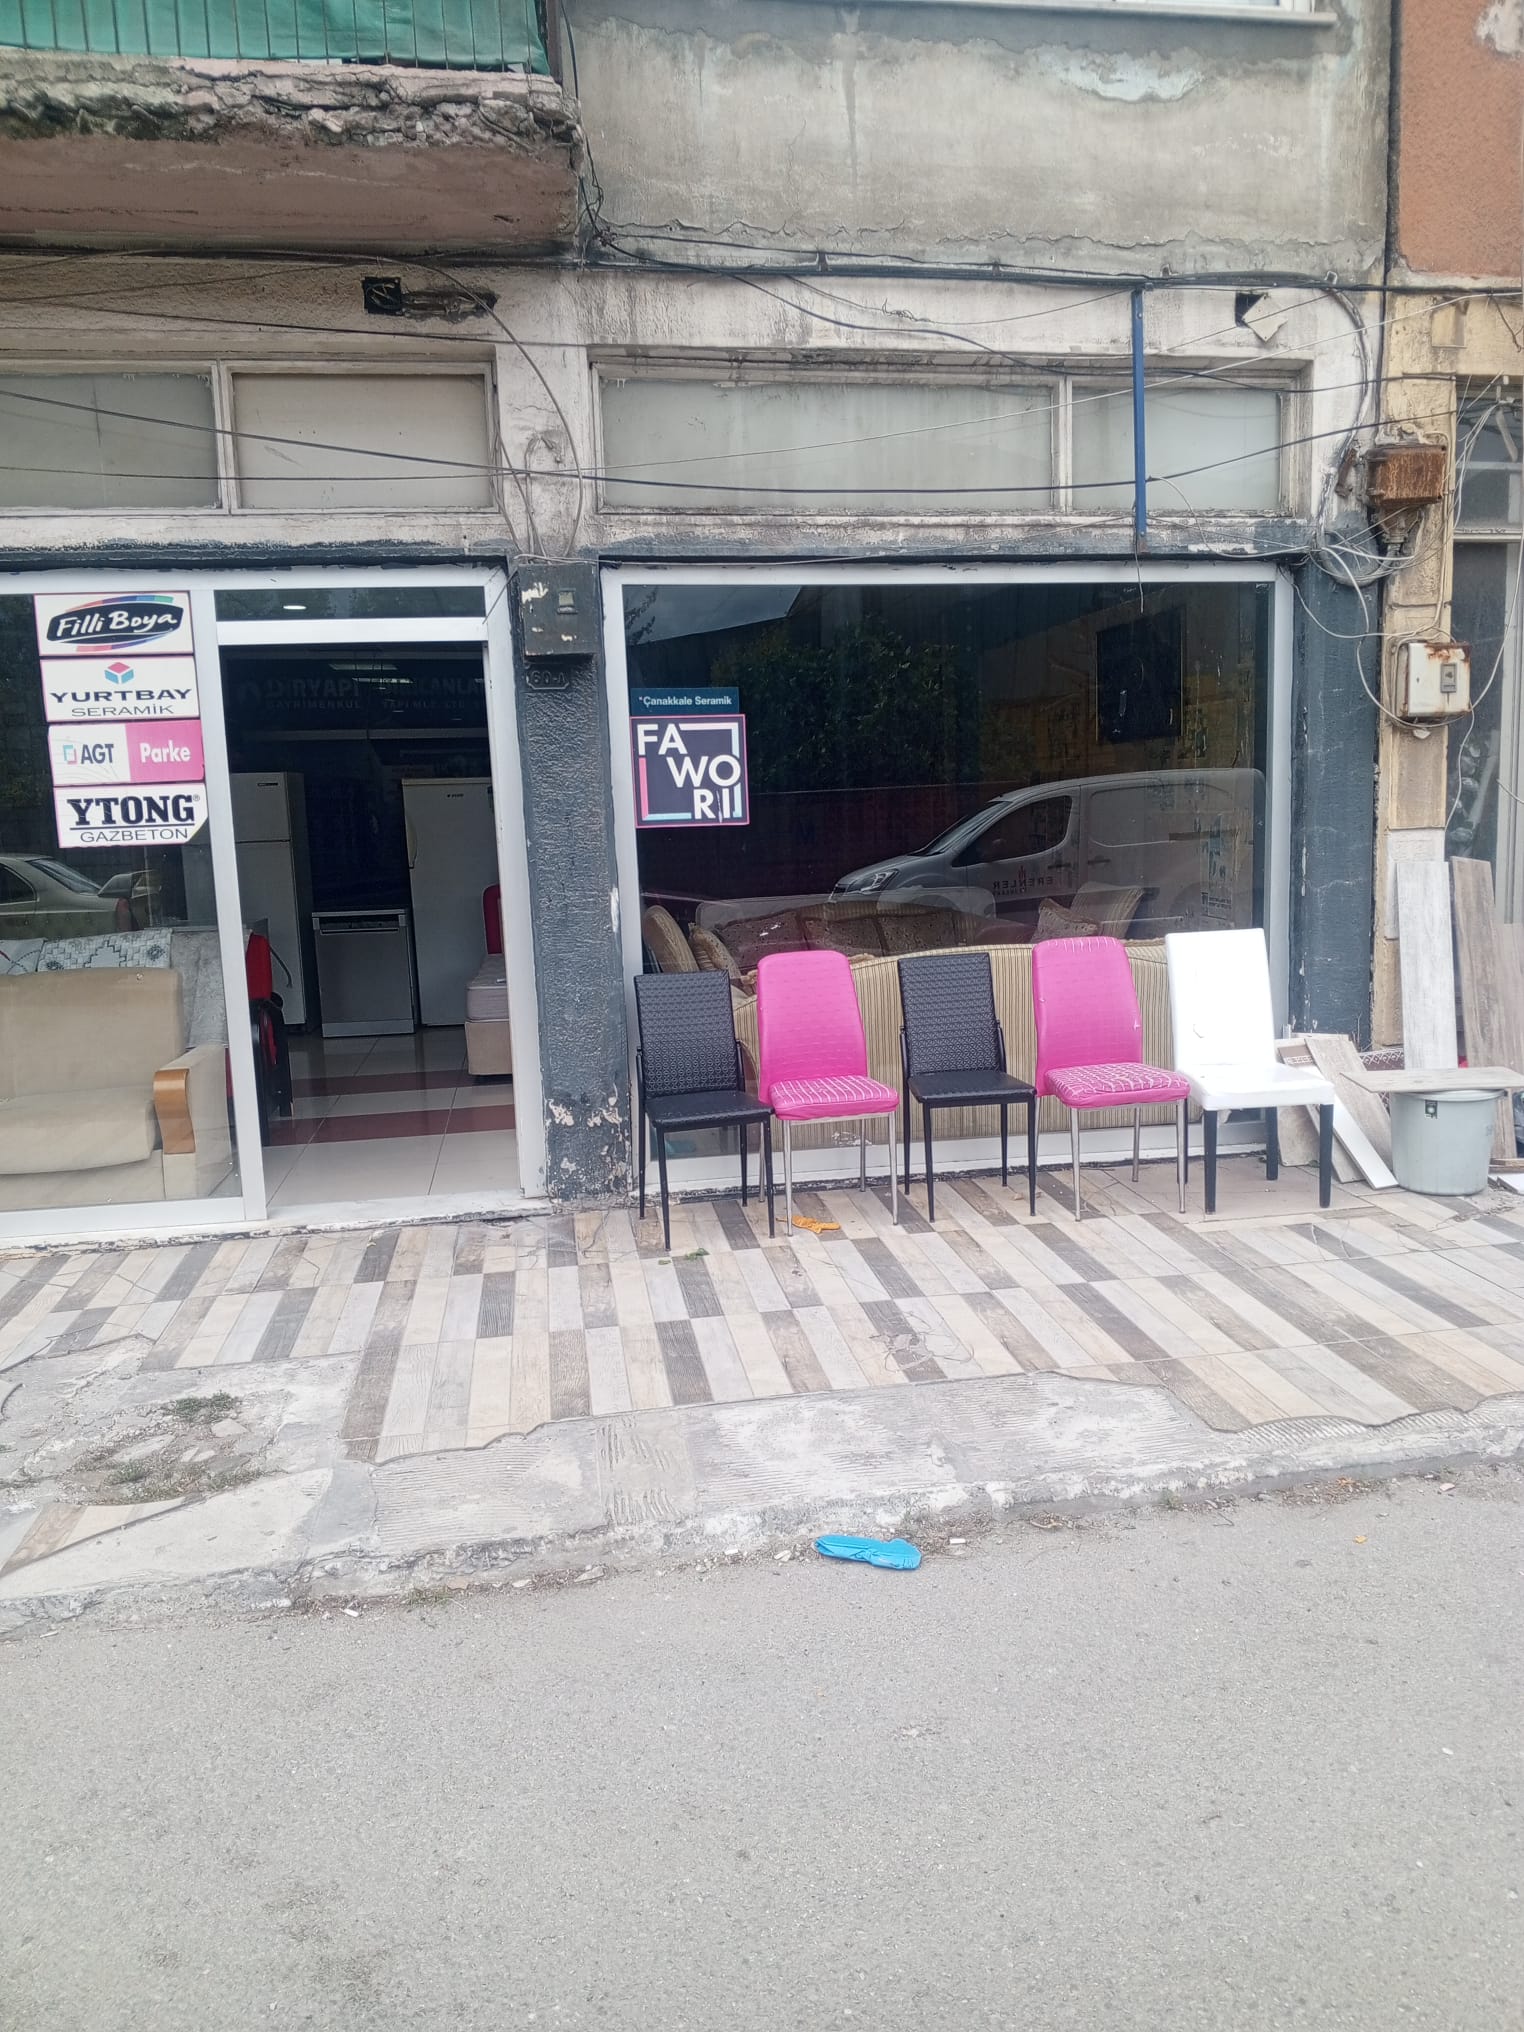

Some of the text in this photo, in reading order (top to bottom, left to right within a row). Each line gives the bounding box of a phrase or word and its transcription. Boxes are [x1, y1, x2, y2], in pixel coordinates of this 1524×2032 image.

[56, 610, 178, 637] Filli Boya
[50, 688, 192, 703] YURTBAY
[643, 696, 732, 708] Çanakkale Seramik
[71, 704, 174, 717] SERAMİK
[81, 743, 191, 764] AGT Parke
[67, 794, 195, 826] YTONG
[80, 828, 188, 843] GAZBETON
